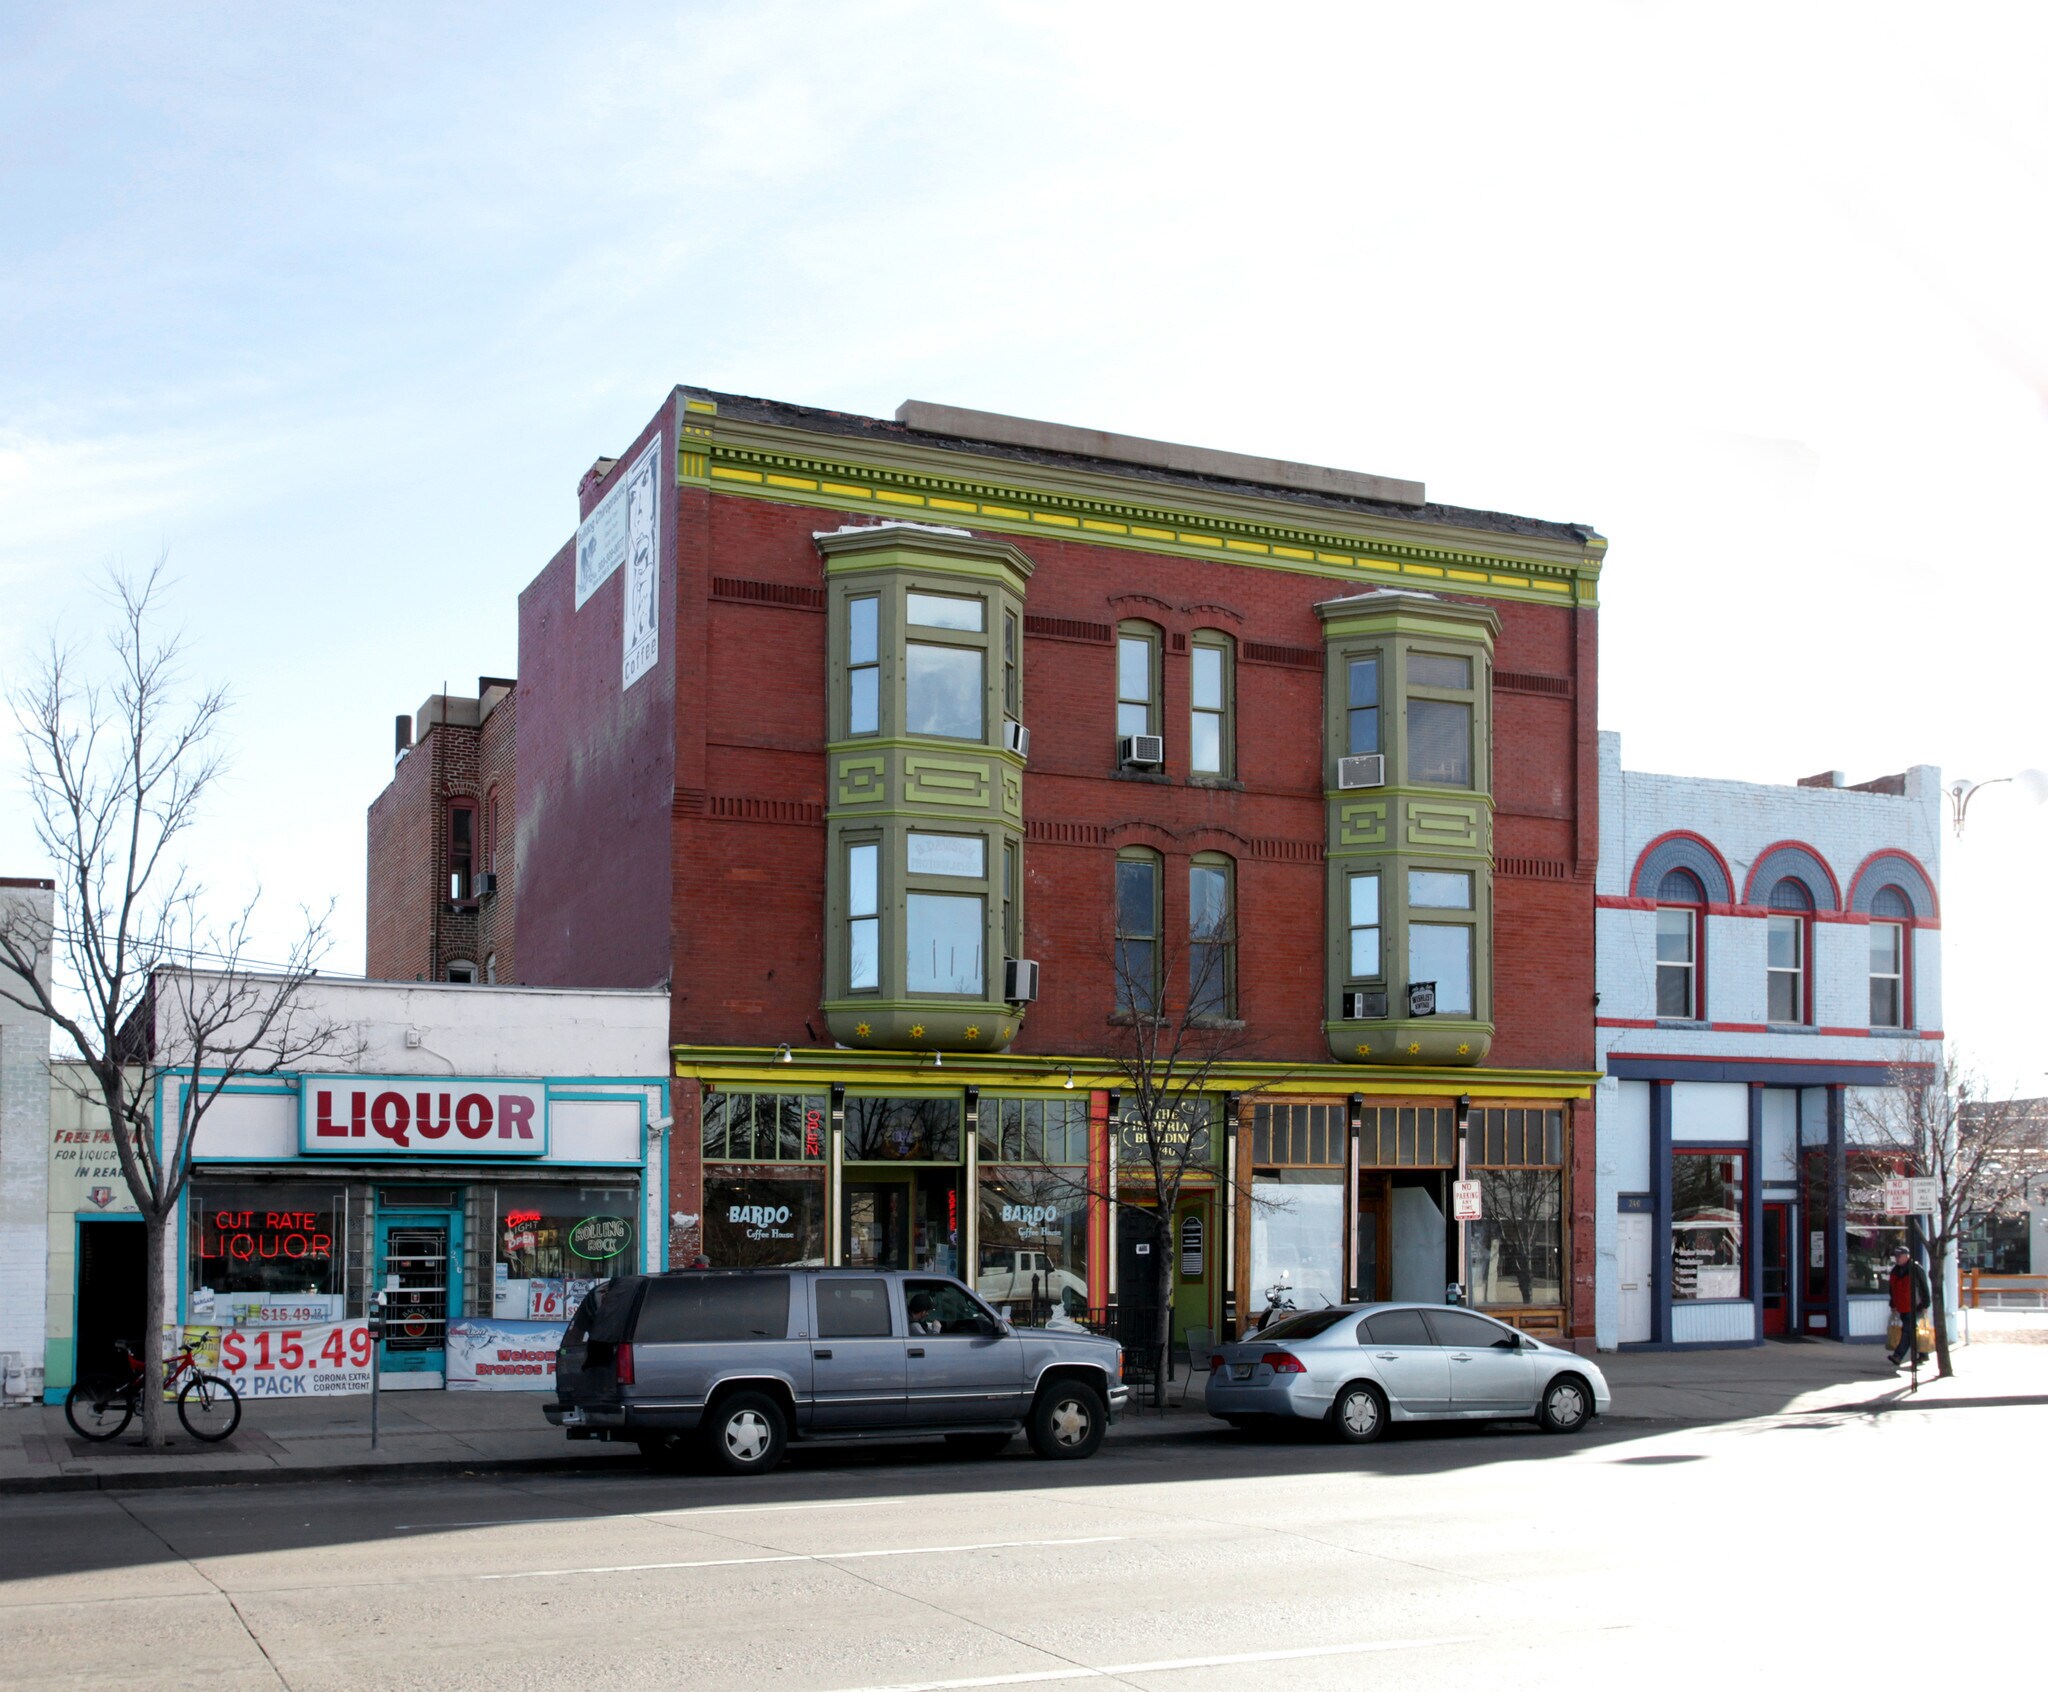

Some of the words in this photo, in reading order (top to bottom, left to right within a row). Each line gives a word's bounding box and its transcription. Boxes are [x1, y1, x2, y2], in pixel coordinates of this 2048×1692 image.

[625, 637, 657, 680] Coffee
[317, 1090, 535, 1147] LIQUOR
[1155, 1108, 1180, 1120] THE
[54, 1129, 91, 1144] FREE
[806, 1109, 820, 1156] OPEN
[55, 1150, 77, 1160] FOR
[79, 1150, 118, 1161] LIQUOR
[74, 1167, 90, 1178] IN
[1461, 1183, 1472, 1191] NO
[216, 1211, 254, 1229] CUT
[266, 1212, 316, 1231] RATE
[729, 1205, 790, 1228] BARDO
[1002, 1205, 1057, 1227] BARDO
[575, 1221, 625, 1242] ROLLING
[746, 1229, 769, 1240] Coffee
[772, 1229, 794, 1239] House
[1018, 1227, 1039, 1238] Coffee
[1041, 1227, 1062, 1236] House
[201, 1234, 331, 1262] LIQUOR
[508, 1232, 535, 1249] OPEN
[588, 1239, 617, 1252] ROCK
[261, 1307, 310, 1322] $15.49
[221, 1327, 371, 1375] $15.49
[497, 1349, 557, 1362] Welcom
[475, 1363, 543, 1376] Broncos
[253, 1374, 306, 1395] PACK
[313, 1374, 347, 1383] CORONA
[348, 1372, 370, 1382] EXTRA
[313, 1382, 347, 1392] CORONA
[348, 1381, 370, 1391] LIGHT
